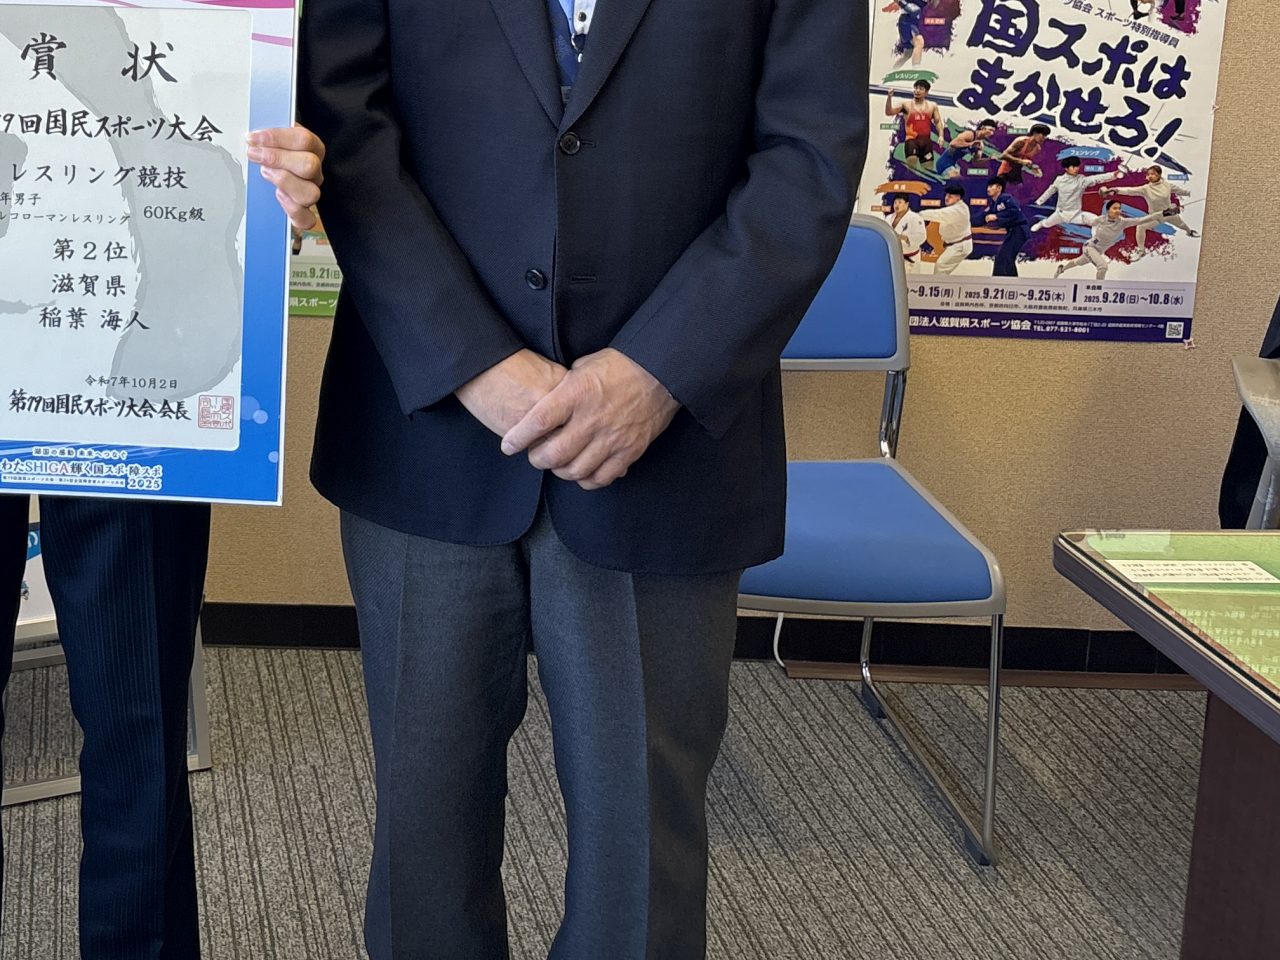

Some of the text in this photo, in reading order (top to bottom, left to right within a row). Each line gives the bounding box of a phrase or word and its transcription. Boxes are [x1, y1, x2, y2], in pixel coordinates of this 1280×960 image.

[1094, 6, 1181, 49] スポーツ特別指導員
[11, 163, 189, 190] レスリング競技
[143, 205, 206, 223] 60Kg級
[51, 237, 129, 262] 第2位
[51, 273, 126, 297] 滋賀県
[38, 306, 151, 331] 稲葉 海人
[84, 374, 178, 390] 令和7年10月2日
[8, 388, 192, 422] 第79回国民スポーツ大会会長
[128, 477, 162, 490] 2025
